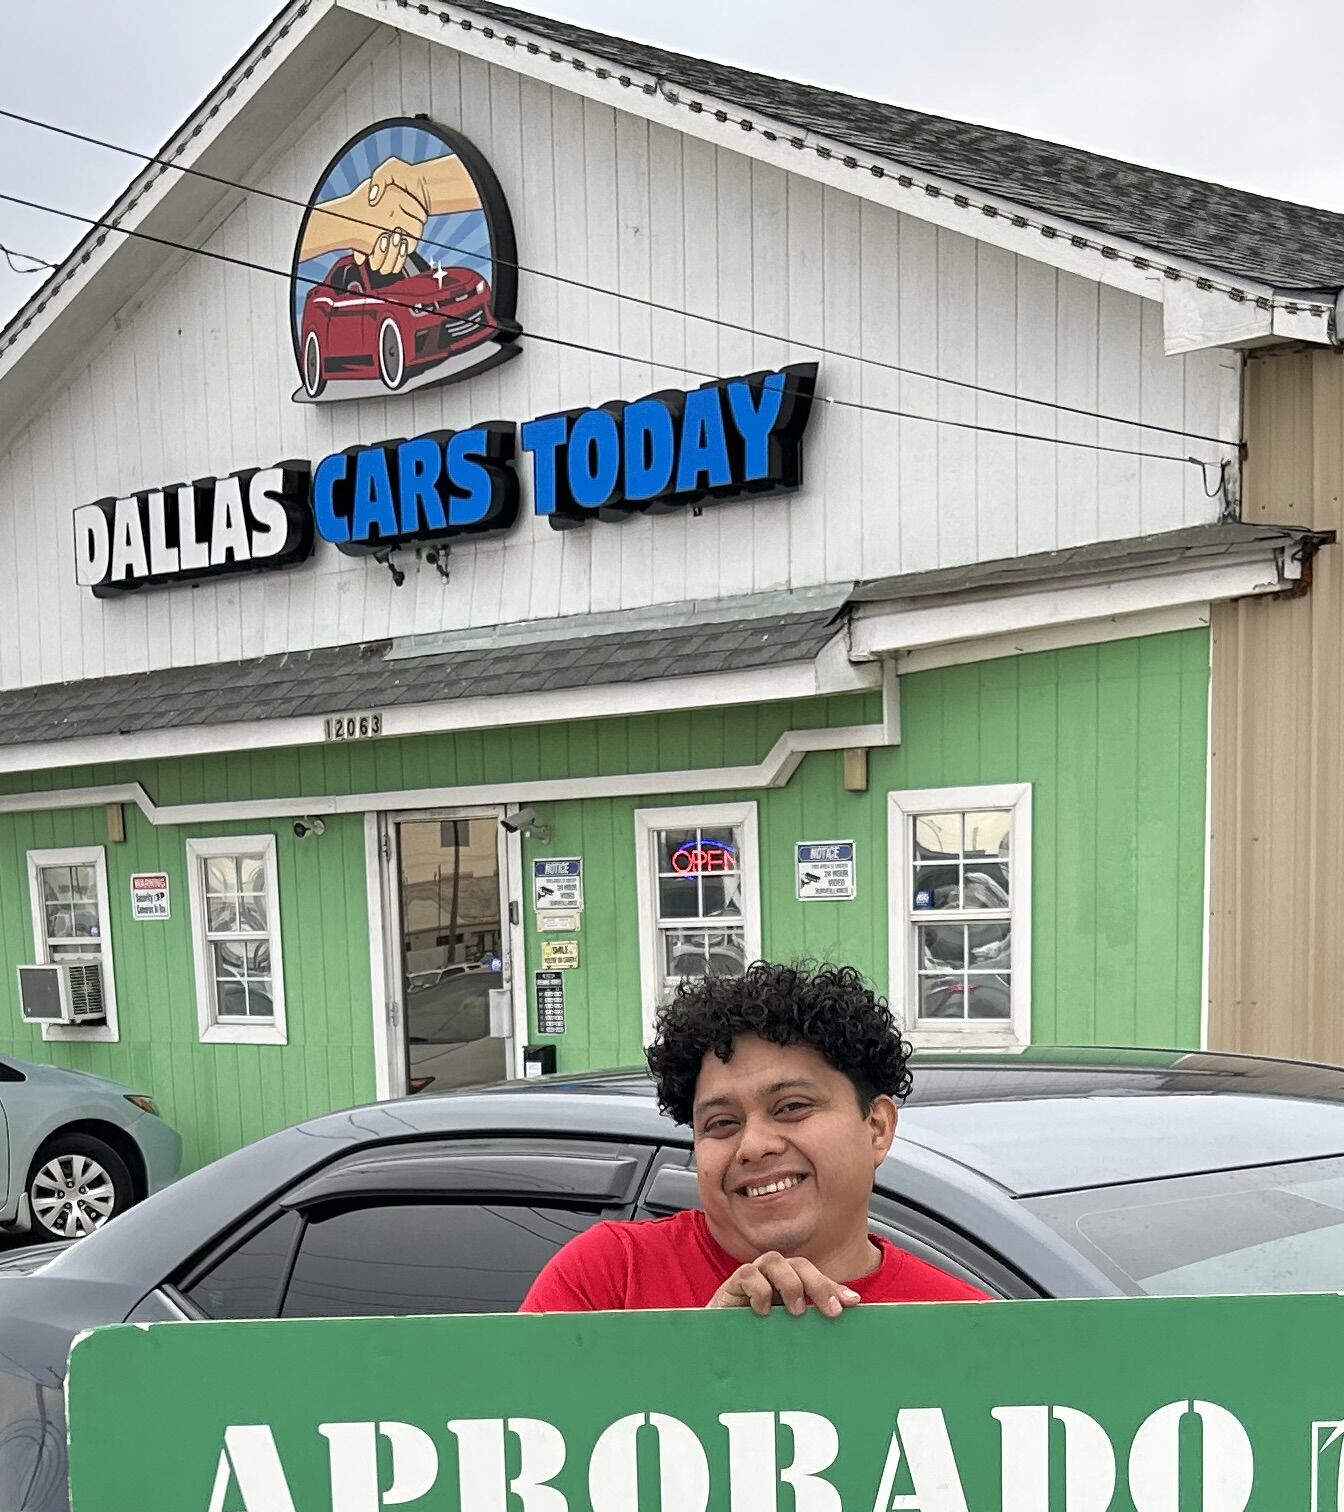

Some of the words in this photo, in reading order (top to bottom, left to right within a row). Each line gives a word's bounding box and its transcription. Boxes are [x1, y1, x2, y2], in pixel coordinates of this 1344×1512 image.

[73, 468, 290, 587] DALLAS
[313, 428, 493, 544] CARS
[521, 372, 787, 517] TODAY
[326, 714, 380, 739] 12063
[672, 849, 737, 873] OPEN
[810, 845, 841, 860] NOTICE
